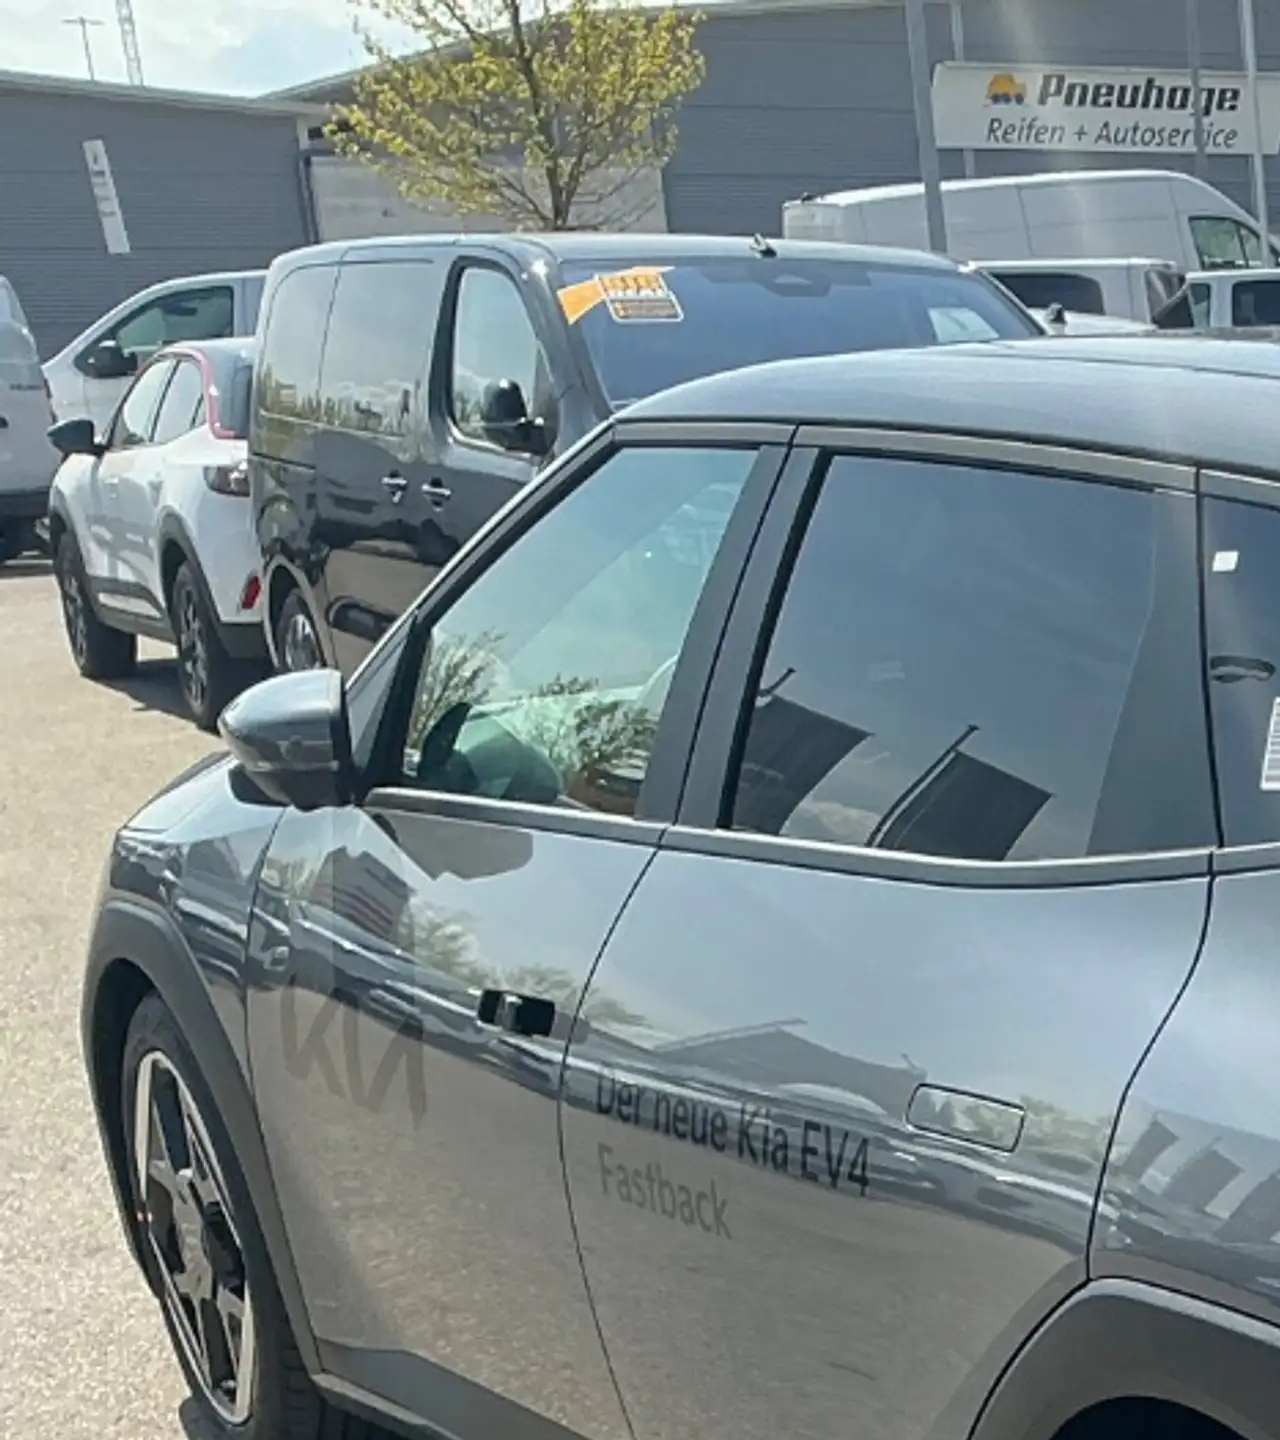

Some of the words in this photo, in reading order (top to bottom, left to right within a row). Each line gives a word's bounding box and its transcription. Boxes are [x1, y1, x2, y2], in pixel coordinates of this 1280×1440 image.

[986, 117, 1066, 145] Reifen
[1073, 126, 1089, 143] +
[1095, 121, 1239, 150] Autoserice
[1038, 74, 1241, 117] Pneuhage
[280, 970, 427, 1131] KIA
[596, 1071, 642, 1127] Der
[653, 1090, 728, 1153] neue
[737, 1099, 789, 1174] Kia
[801, 1119, 870, 1197] EV4
[598, 1142, 733, 1240] Fastback
